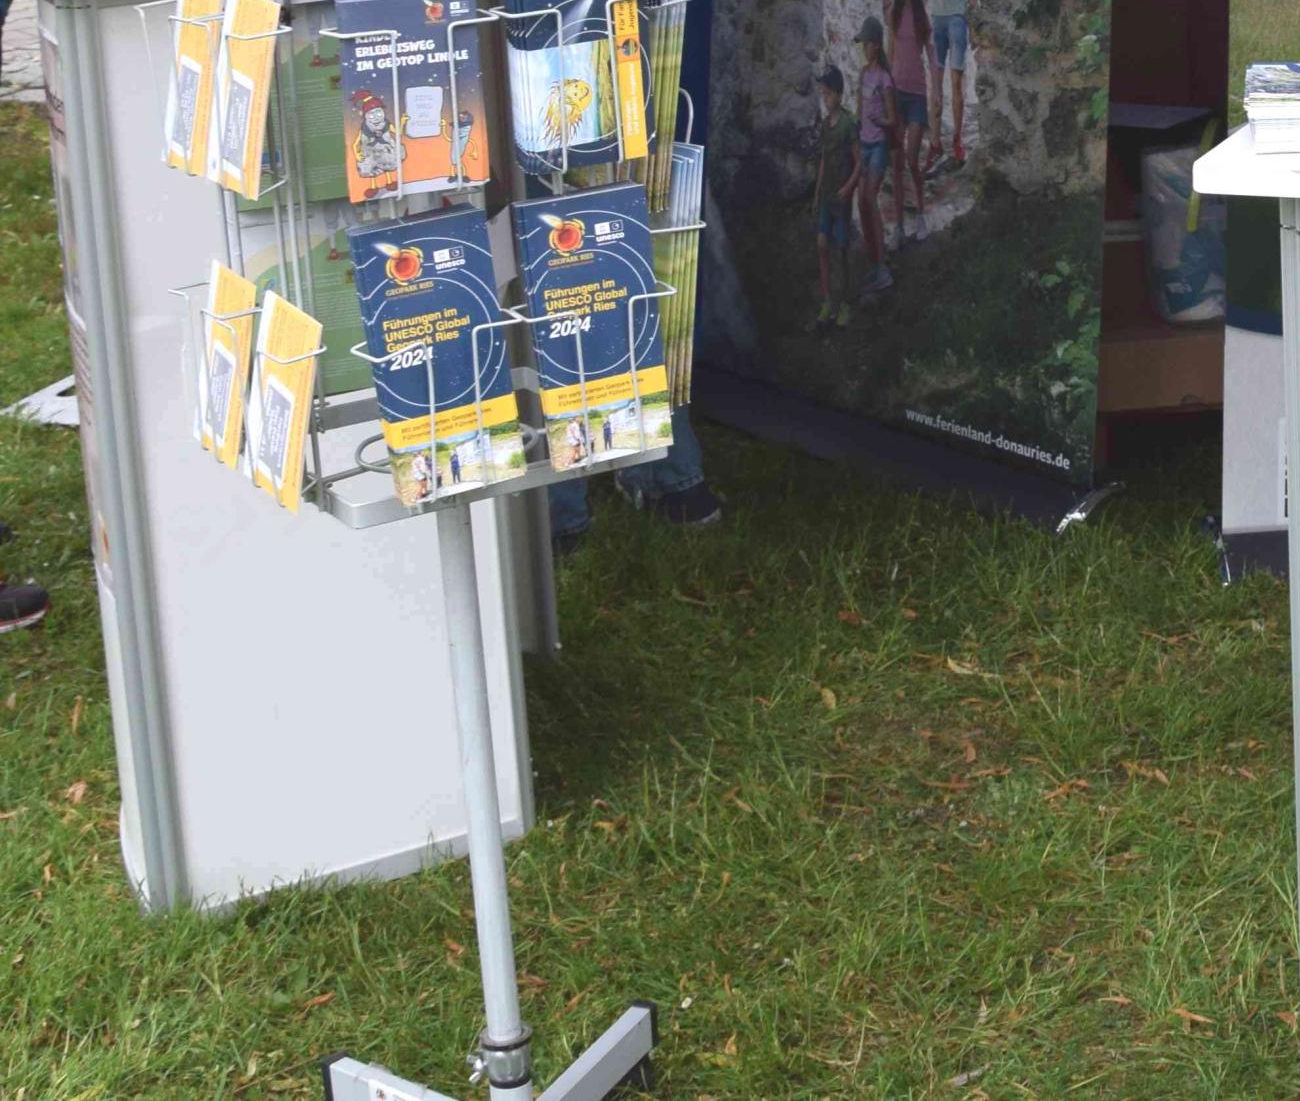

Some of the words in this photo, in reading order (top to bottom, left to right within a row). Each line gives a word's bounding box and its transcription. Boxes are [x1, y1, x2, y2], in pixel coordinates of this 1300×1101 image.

[355, 40, 436, 58] ERLEBISWEG
[356, 60, 374, 72] IM
[595, 232, 625, 243] unesco
[435, 258, 466, 271] unesco
[547, 255, 579, 267] GEOPARK
[579, 252, 595, 261] RIES
[385, 284, 418, 297] GEOPARK
[418, 280, 434, 290] RIES
[543, 282, 600, 300] Führungen
[602, 279, 616, 289] im
[545, 294, 592, 311] UNESCO
[594, 287, 628, 302] Global
[593, 300, 617, 313] Ries
[383, 311, 442, 331] Führungen
[443, 307, 458, 318] im
[549, 315, 592, 339] 2024
[384, 323, 434, 343] UNESCO
[435, 314, 471, 331] Global
[435, 330, 460, 343] Ries
[906, 408, 1070, 470] www.ferienland-donauries.de
